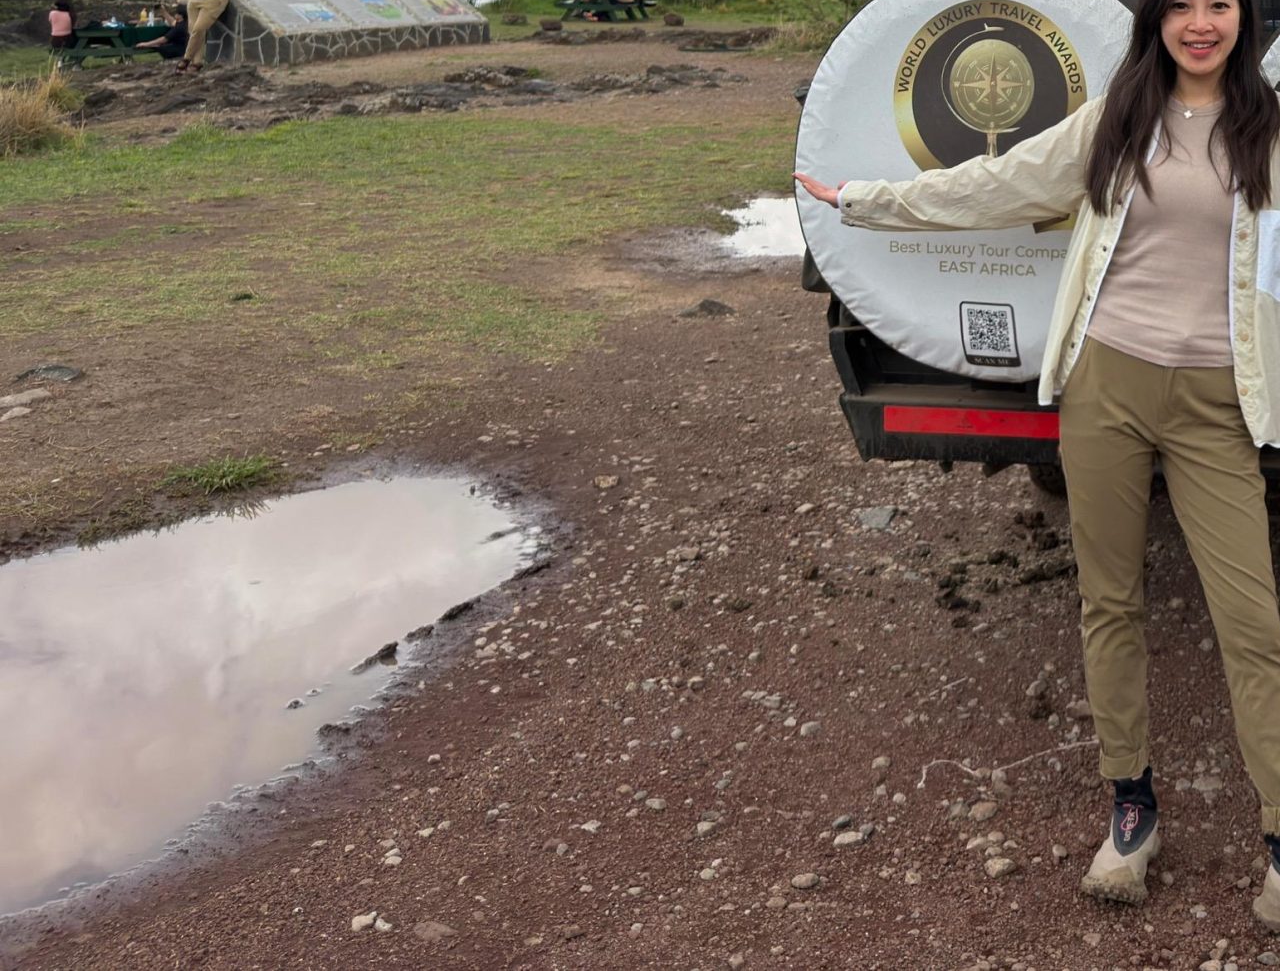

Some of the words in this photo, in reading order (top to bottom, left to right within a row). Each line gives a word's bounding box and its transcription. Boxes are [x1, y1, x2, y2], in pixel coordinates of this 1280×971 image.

[898, 37, 927, 93] WORLD
[926, 3, 984, 37] LUXURY
[990, 2, 1043, 31] TRAVEL
[1045, 31, 1083, 94] AWARDS
[889, 241, 921, 254] Best
[926, 242, 975, 258] Luxury
[979, 244, 1011, 258] Tour
[1015, 245, 1068, 262] Compa
[939, 261, 976, 274] EAST
[979, 263, 1037, 277] AFRICA
